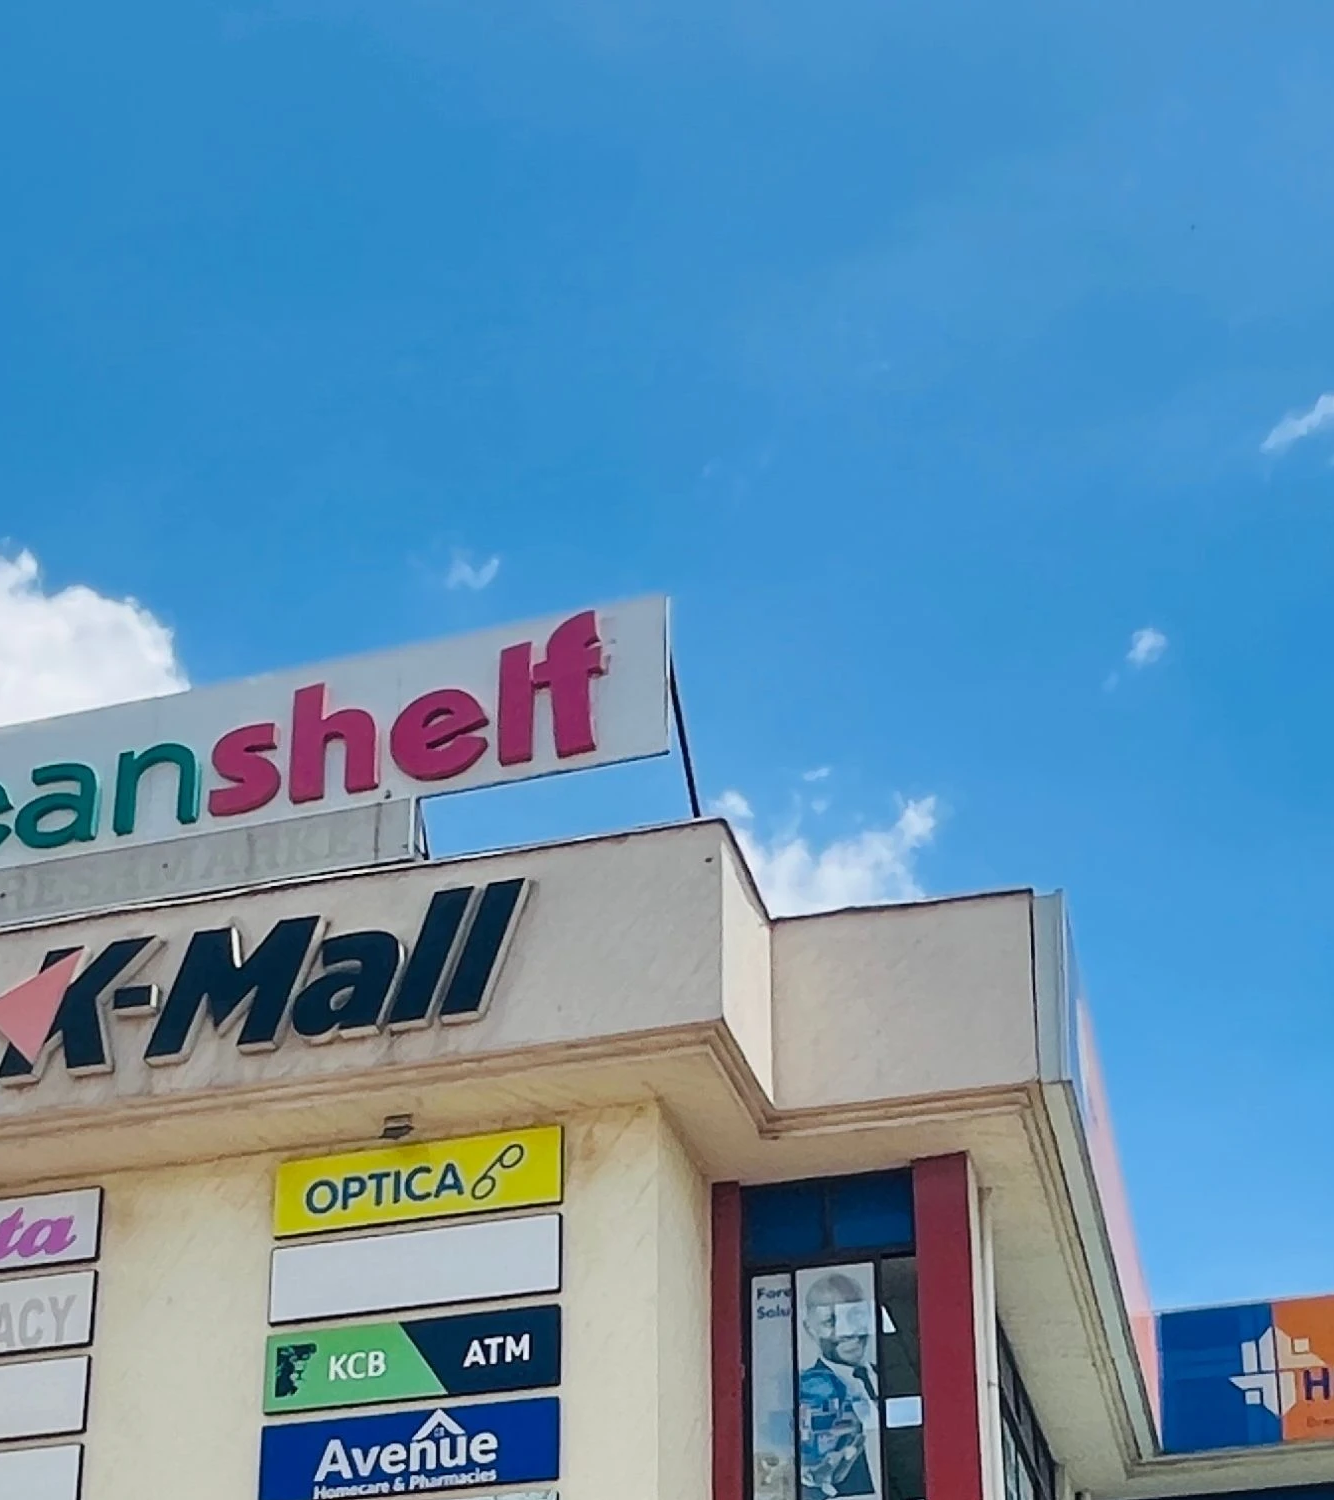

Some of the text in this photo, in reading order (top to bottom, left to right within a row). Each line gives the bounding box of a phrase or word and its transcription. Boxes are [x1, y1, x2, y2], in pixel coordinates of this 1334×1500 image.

[306, 1162, 464, 1214] OPTICA
[328, 1333, 530, 1381] KCB ATM
[313, 1430, 499, 1482] Avenue
[313, 1468, 497, 1500] Homecare & Pharmacies
